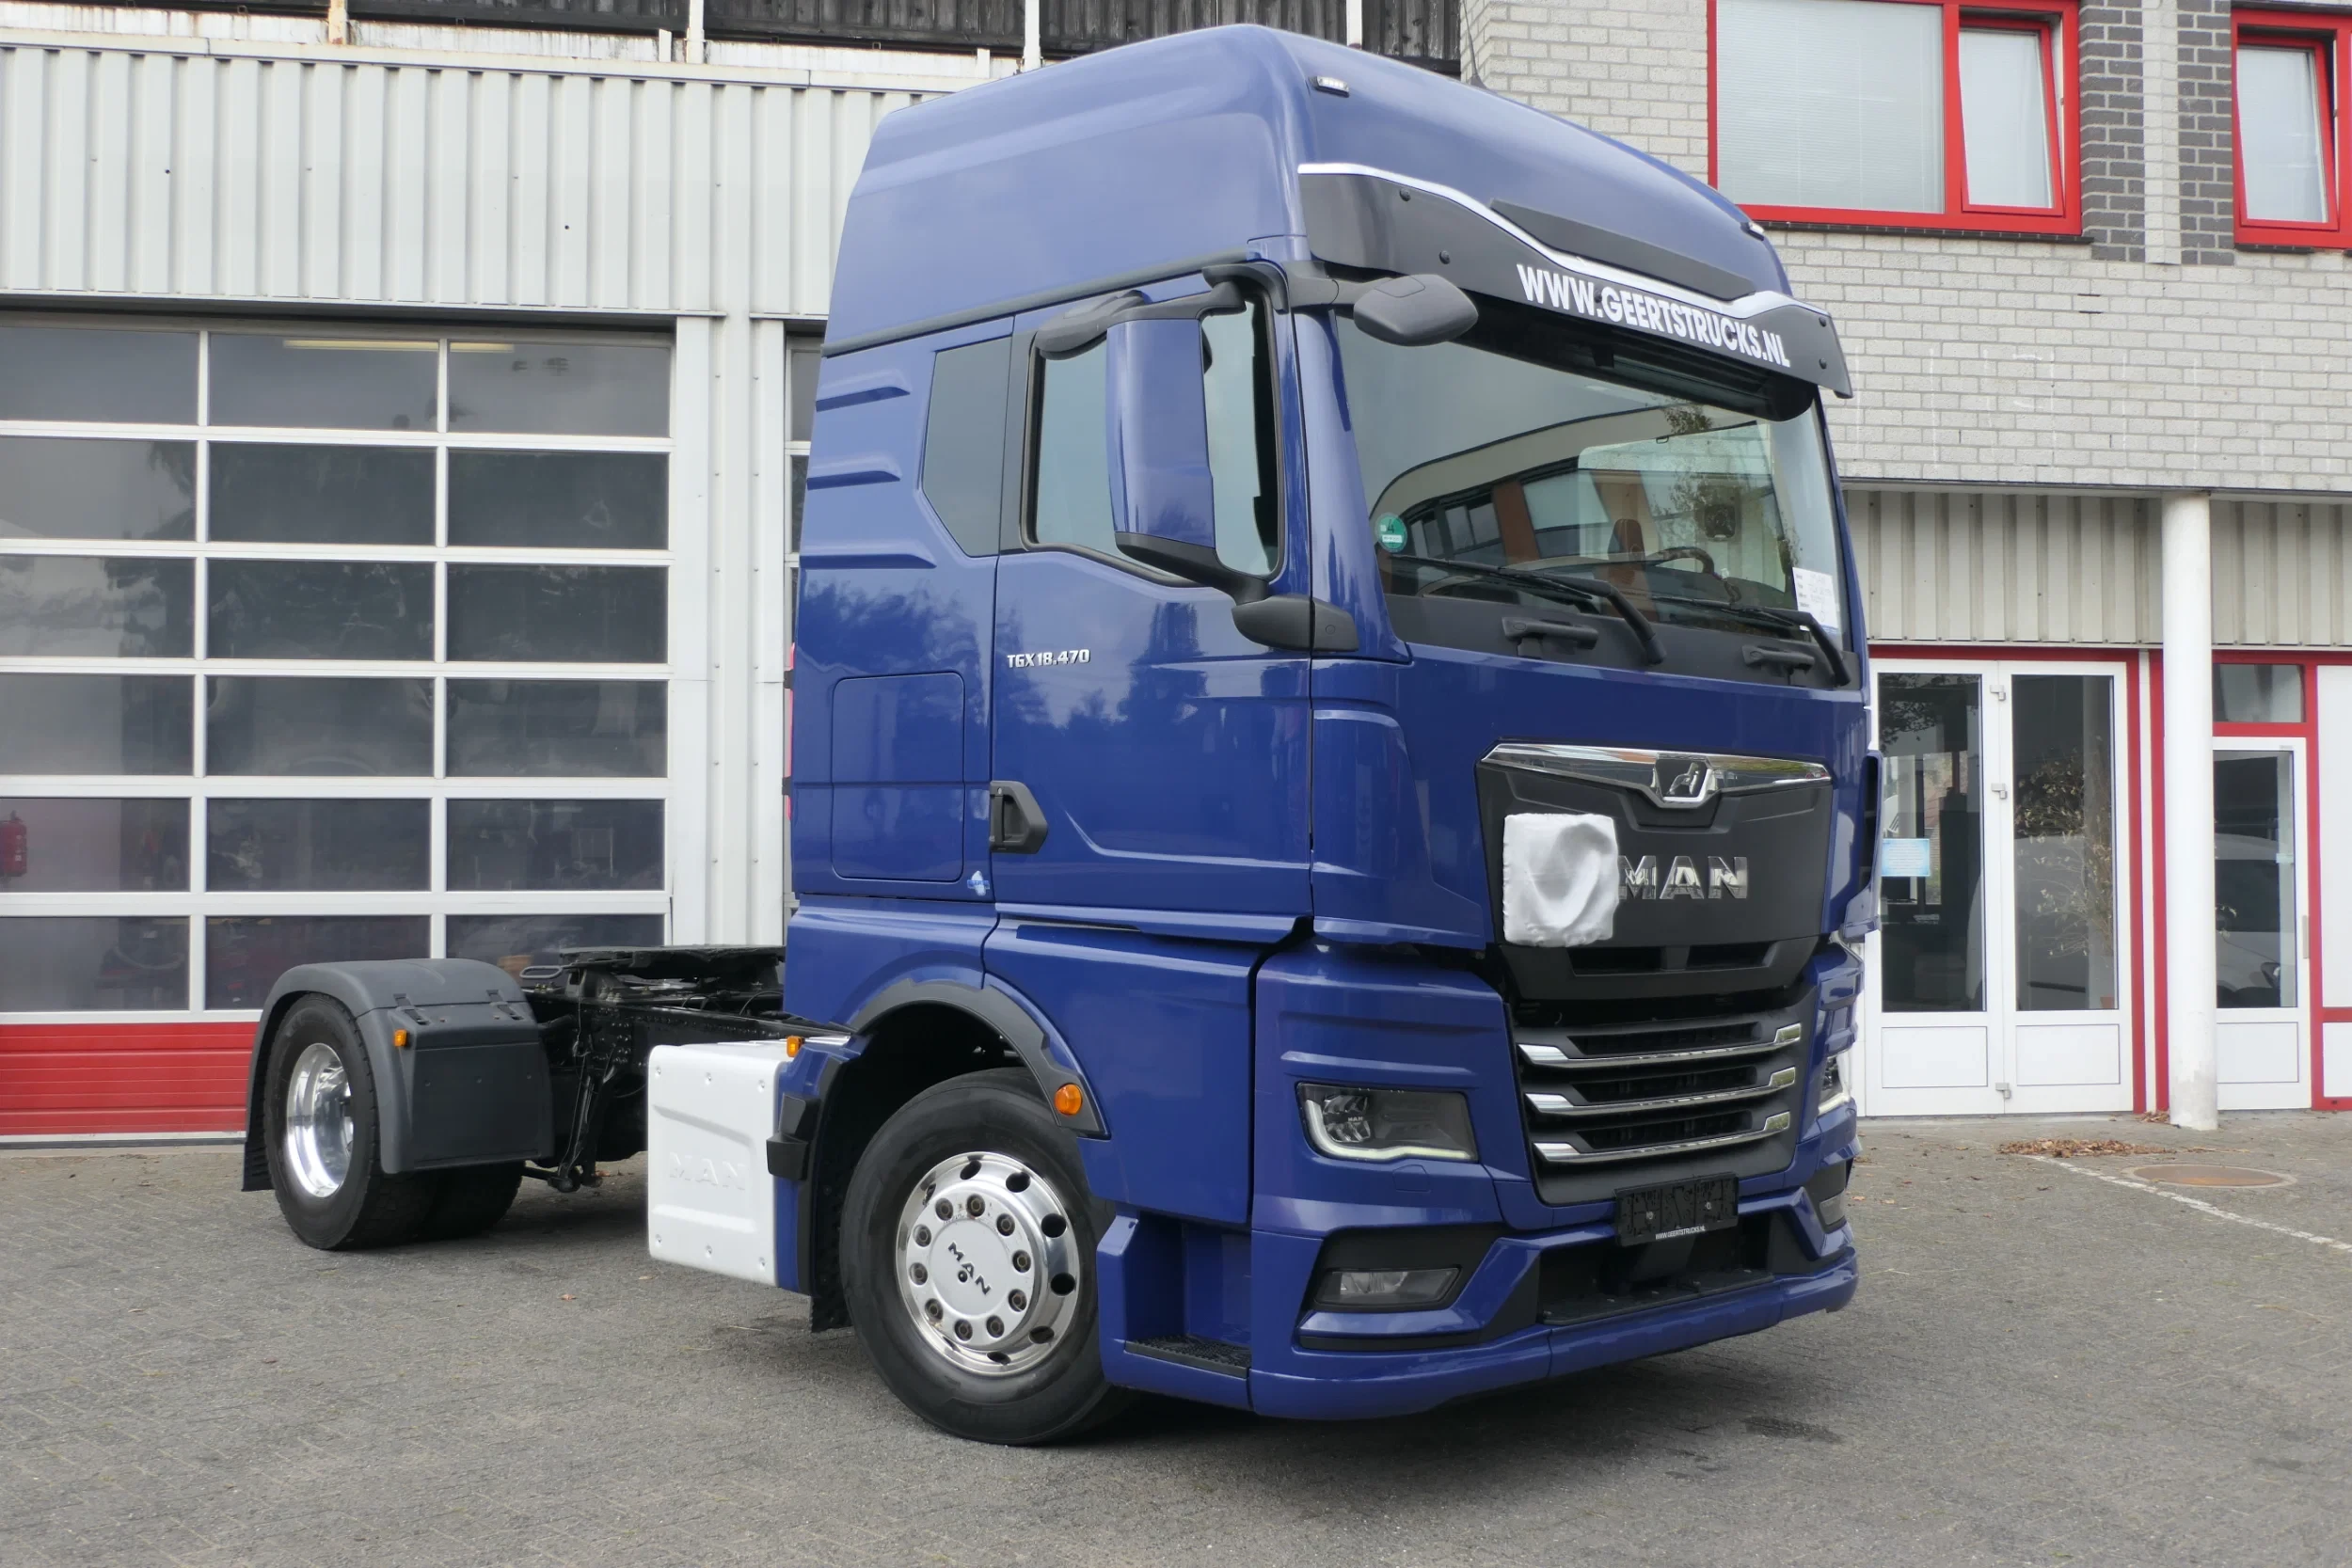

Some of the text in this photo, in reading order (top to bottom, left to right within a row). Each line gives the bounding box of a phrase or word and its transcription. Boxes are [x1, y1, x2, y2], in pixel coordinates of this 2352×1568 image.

[1517, 263, 1790, 368] WWW.GEERTSTRUCKS.NL
[1007, 649, 1090, 668] TGX 18.470
[1618, 855, 1748, 900] MAN
[669, 1152, 747, 1191] MAN
[948, 1242, 991, 1295] MAN
